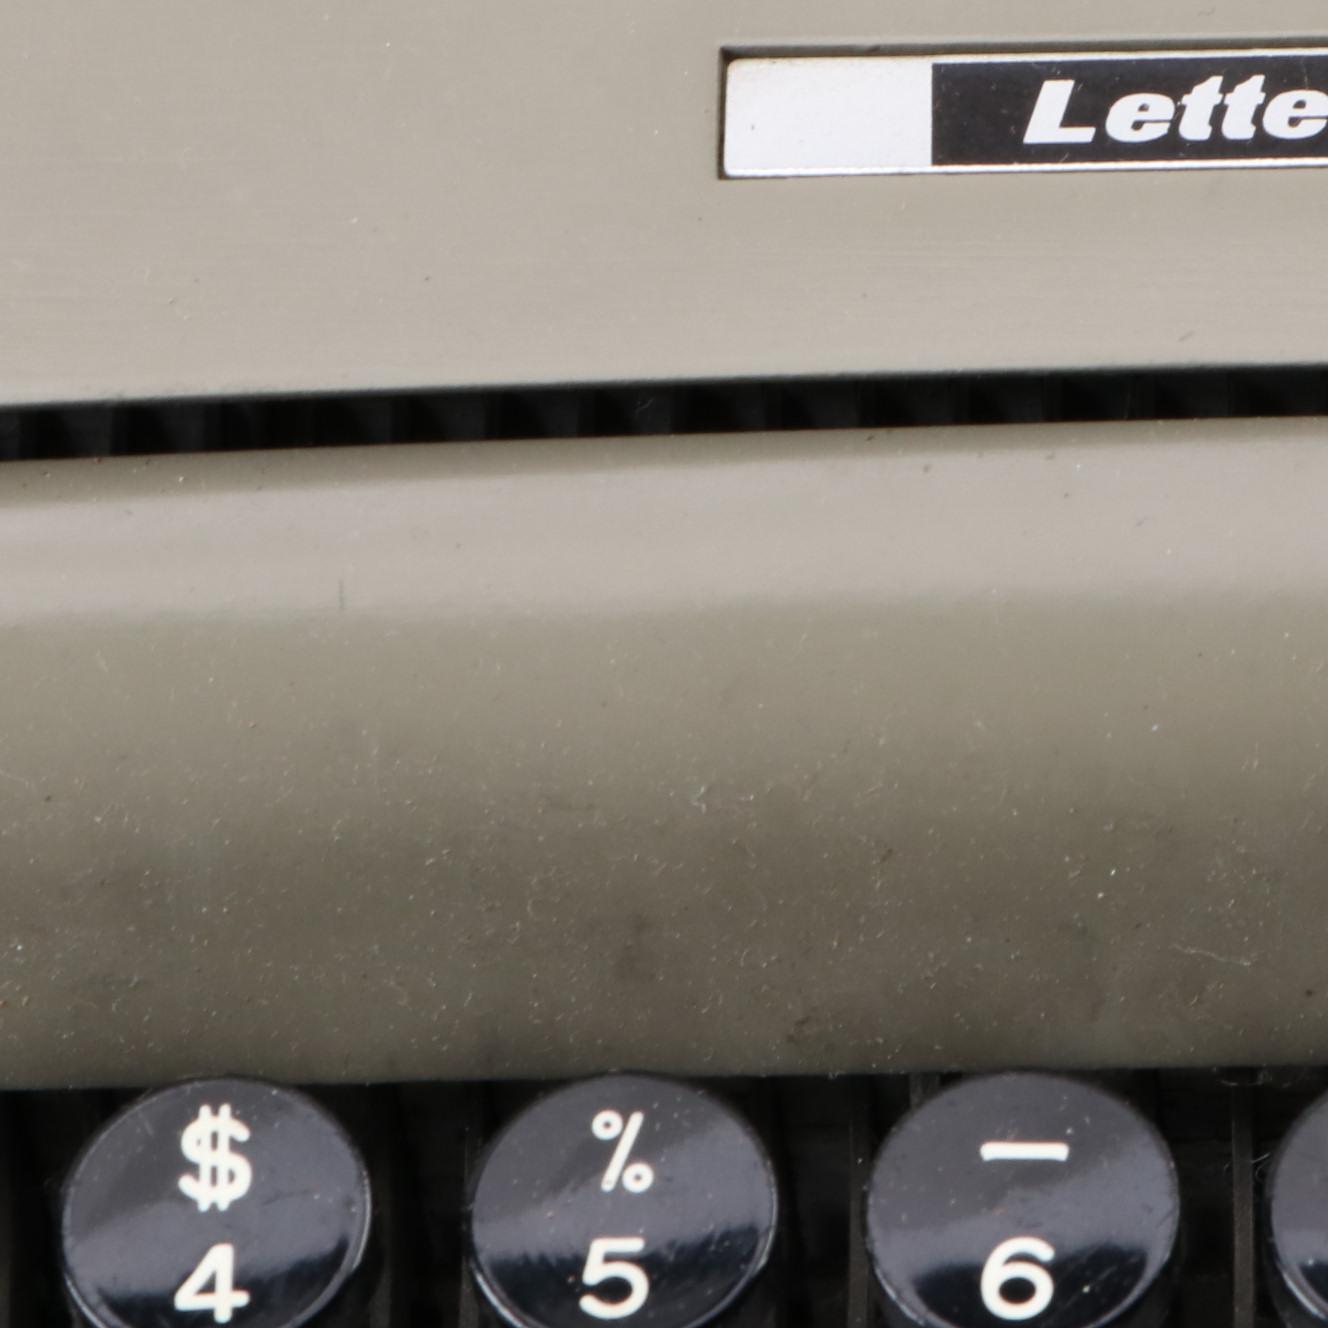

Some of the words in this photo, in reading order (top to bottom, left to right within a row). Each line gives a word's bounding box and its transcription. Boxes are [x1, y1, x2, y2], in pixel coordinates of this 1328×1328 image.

[178, 1102, 253, 1213] $
[590, 1109, 656, 1194] %
[173, 1242, 250, 1323] 4
[579, 1236, 650, 1319] 5
[980, 1236, 1055, 1320] 6
